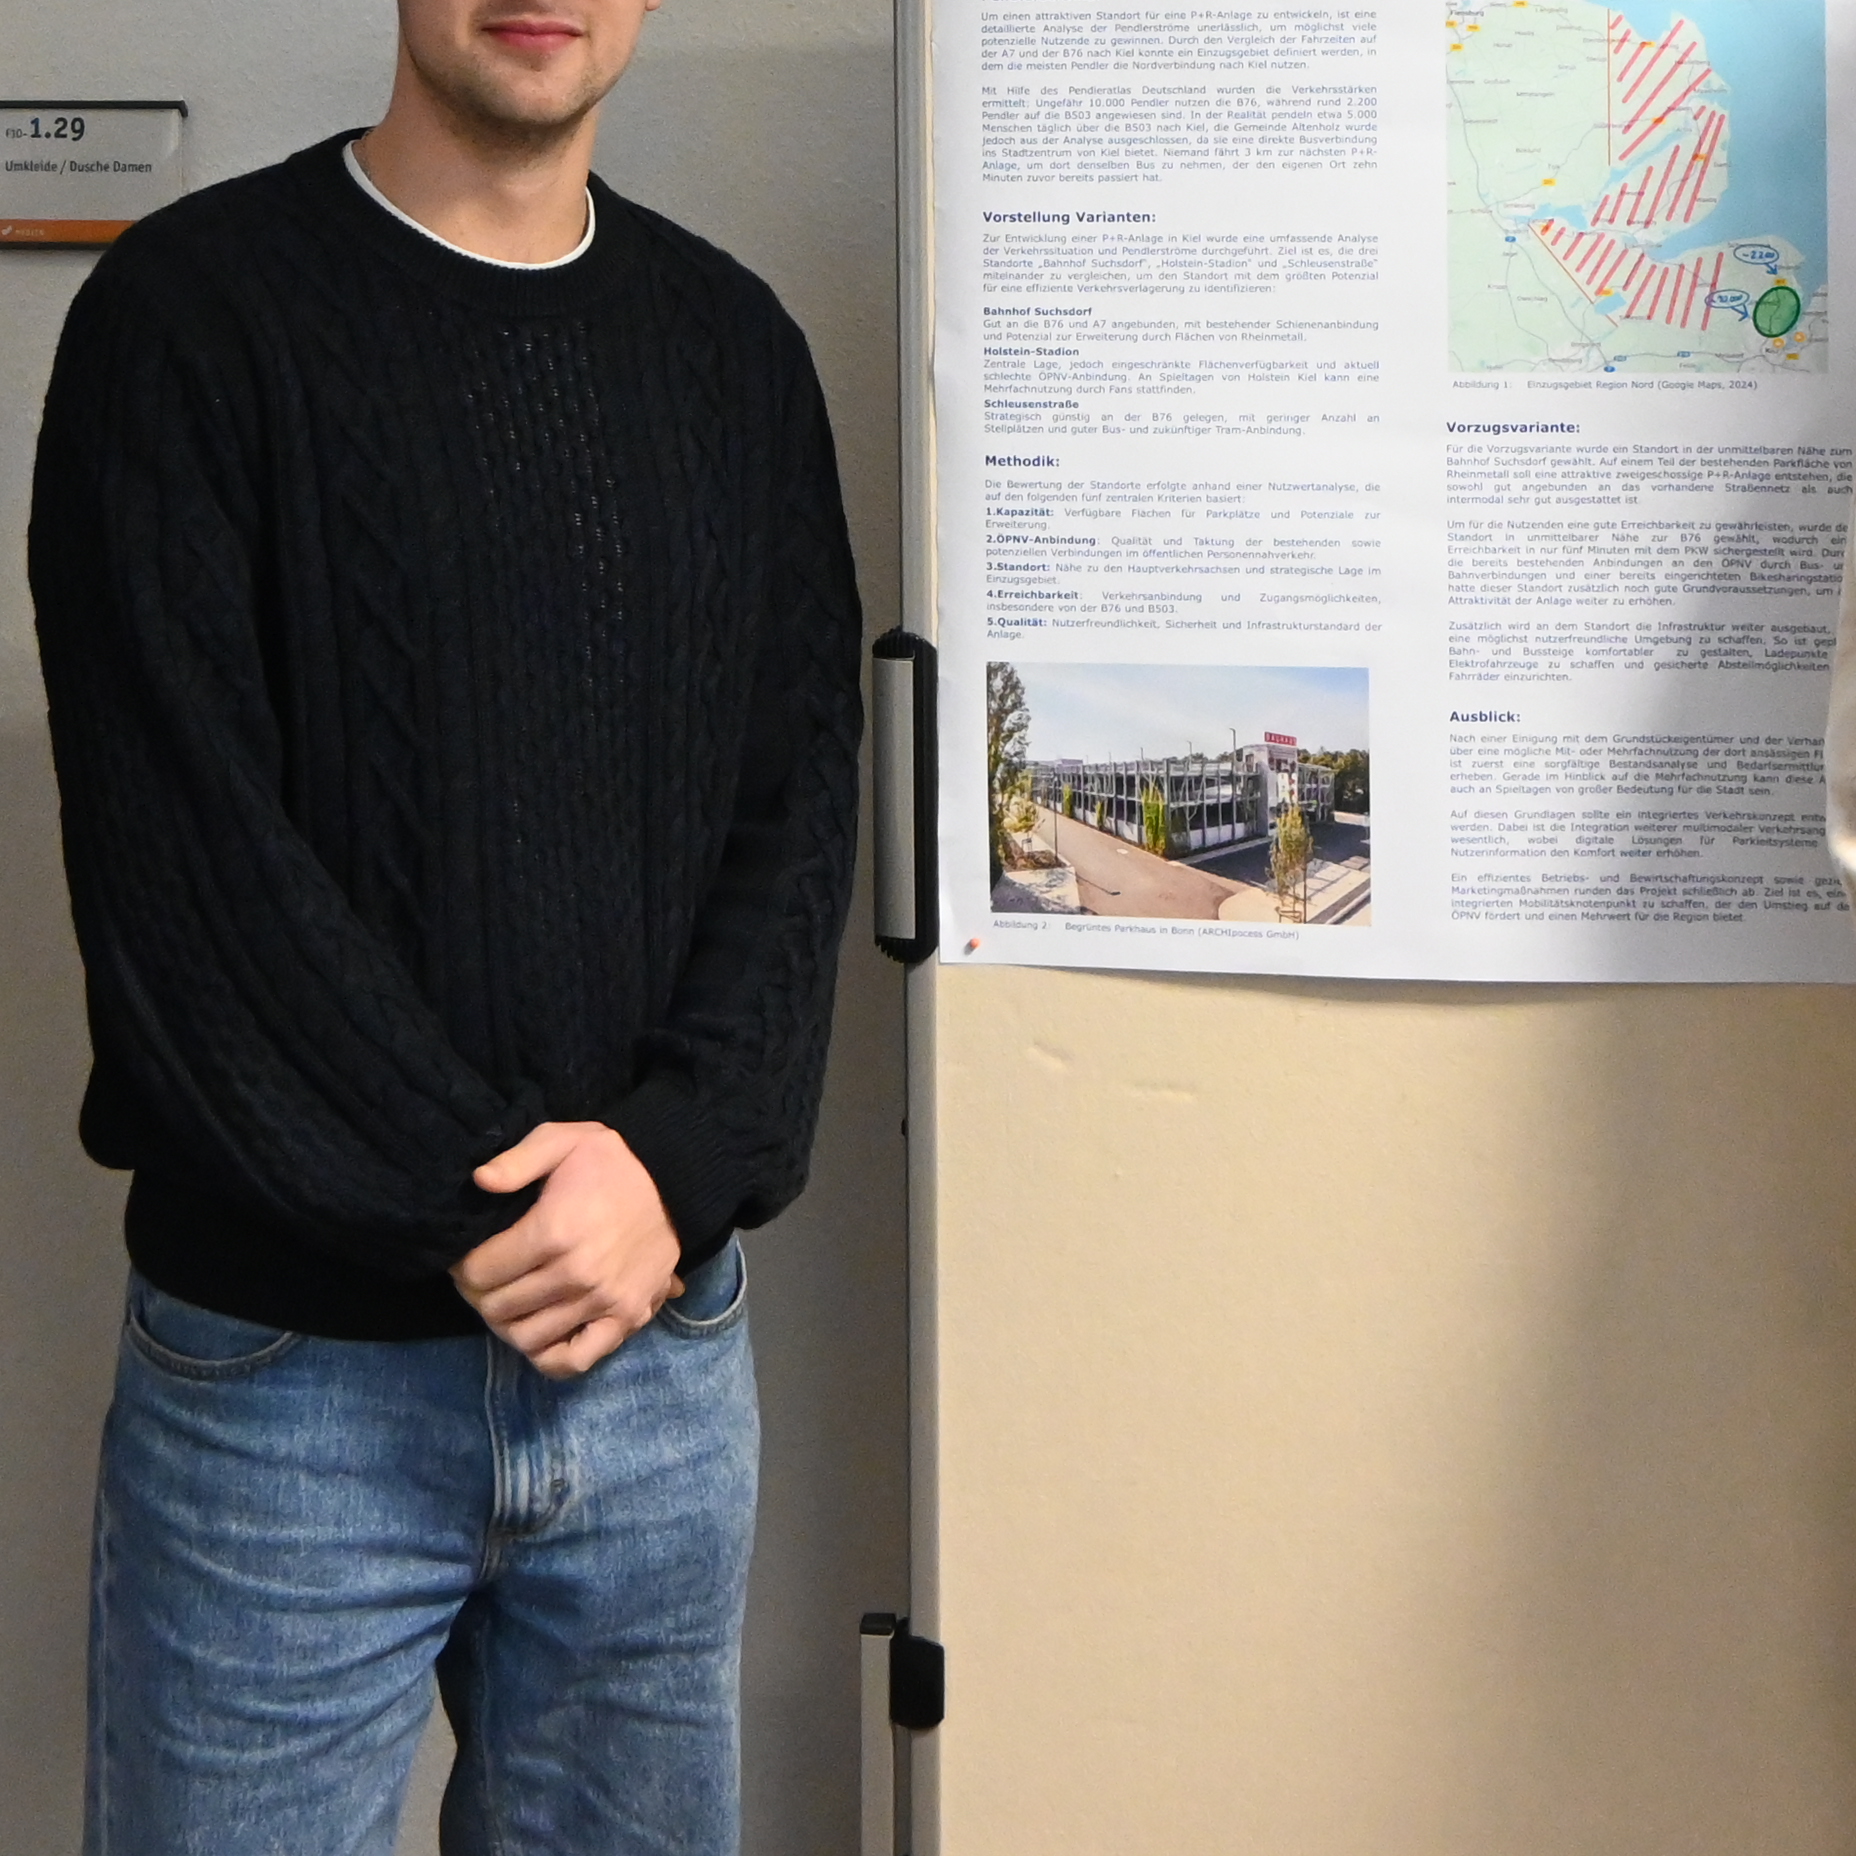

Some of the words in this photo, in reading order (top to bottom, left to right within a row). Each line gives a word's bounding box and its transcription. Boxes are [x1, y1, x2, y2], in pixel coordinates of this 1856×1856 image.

[4, 159, 58, 172] Umkleide
[59, 159, 66, 175] /
[69, 160, 110, 173] Dusche
[112, 160, 152, 173] Damen
[982, 210, 1070, 225] Vorstellung
[1075, 210, 1155, 223] Varianten:
[983, 306, 1031, 316] Bahnhof
[1034, 306, 1092, 316] Suchsdorf
[983, 346, 1079, 356] Holstein-Stadion
[1526, 380, 1592, 391] Einzugsgebiet
[1595, 379, 1628, 391] Region
[1630, 380, 1654, 389] Nord
[983, 398, 1079, 409] Schleusenstraße
[1446, 421, 1580, 435] Vorzugsvariante:
[984, 454, 1059, 467] Methodik:
[986, 506, 1054, 518] 1.Kapazität:
[986, 561, 1050, 572] 3.Standort:
[986, 616, 1046, 628] 5.Qualität:
[1449, 710, 1520, 722] Ausblick:
